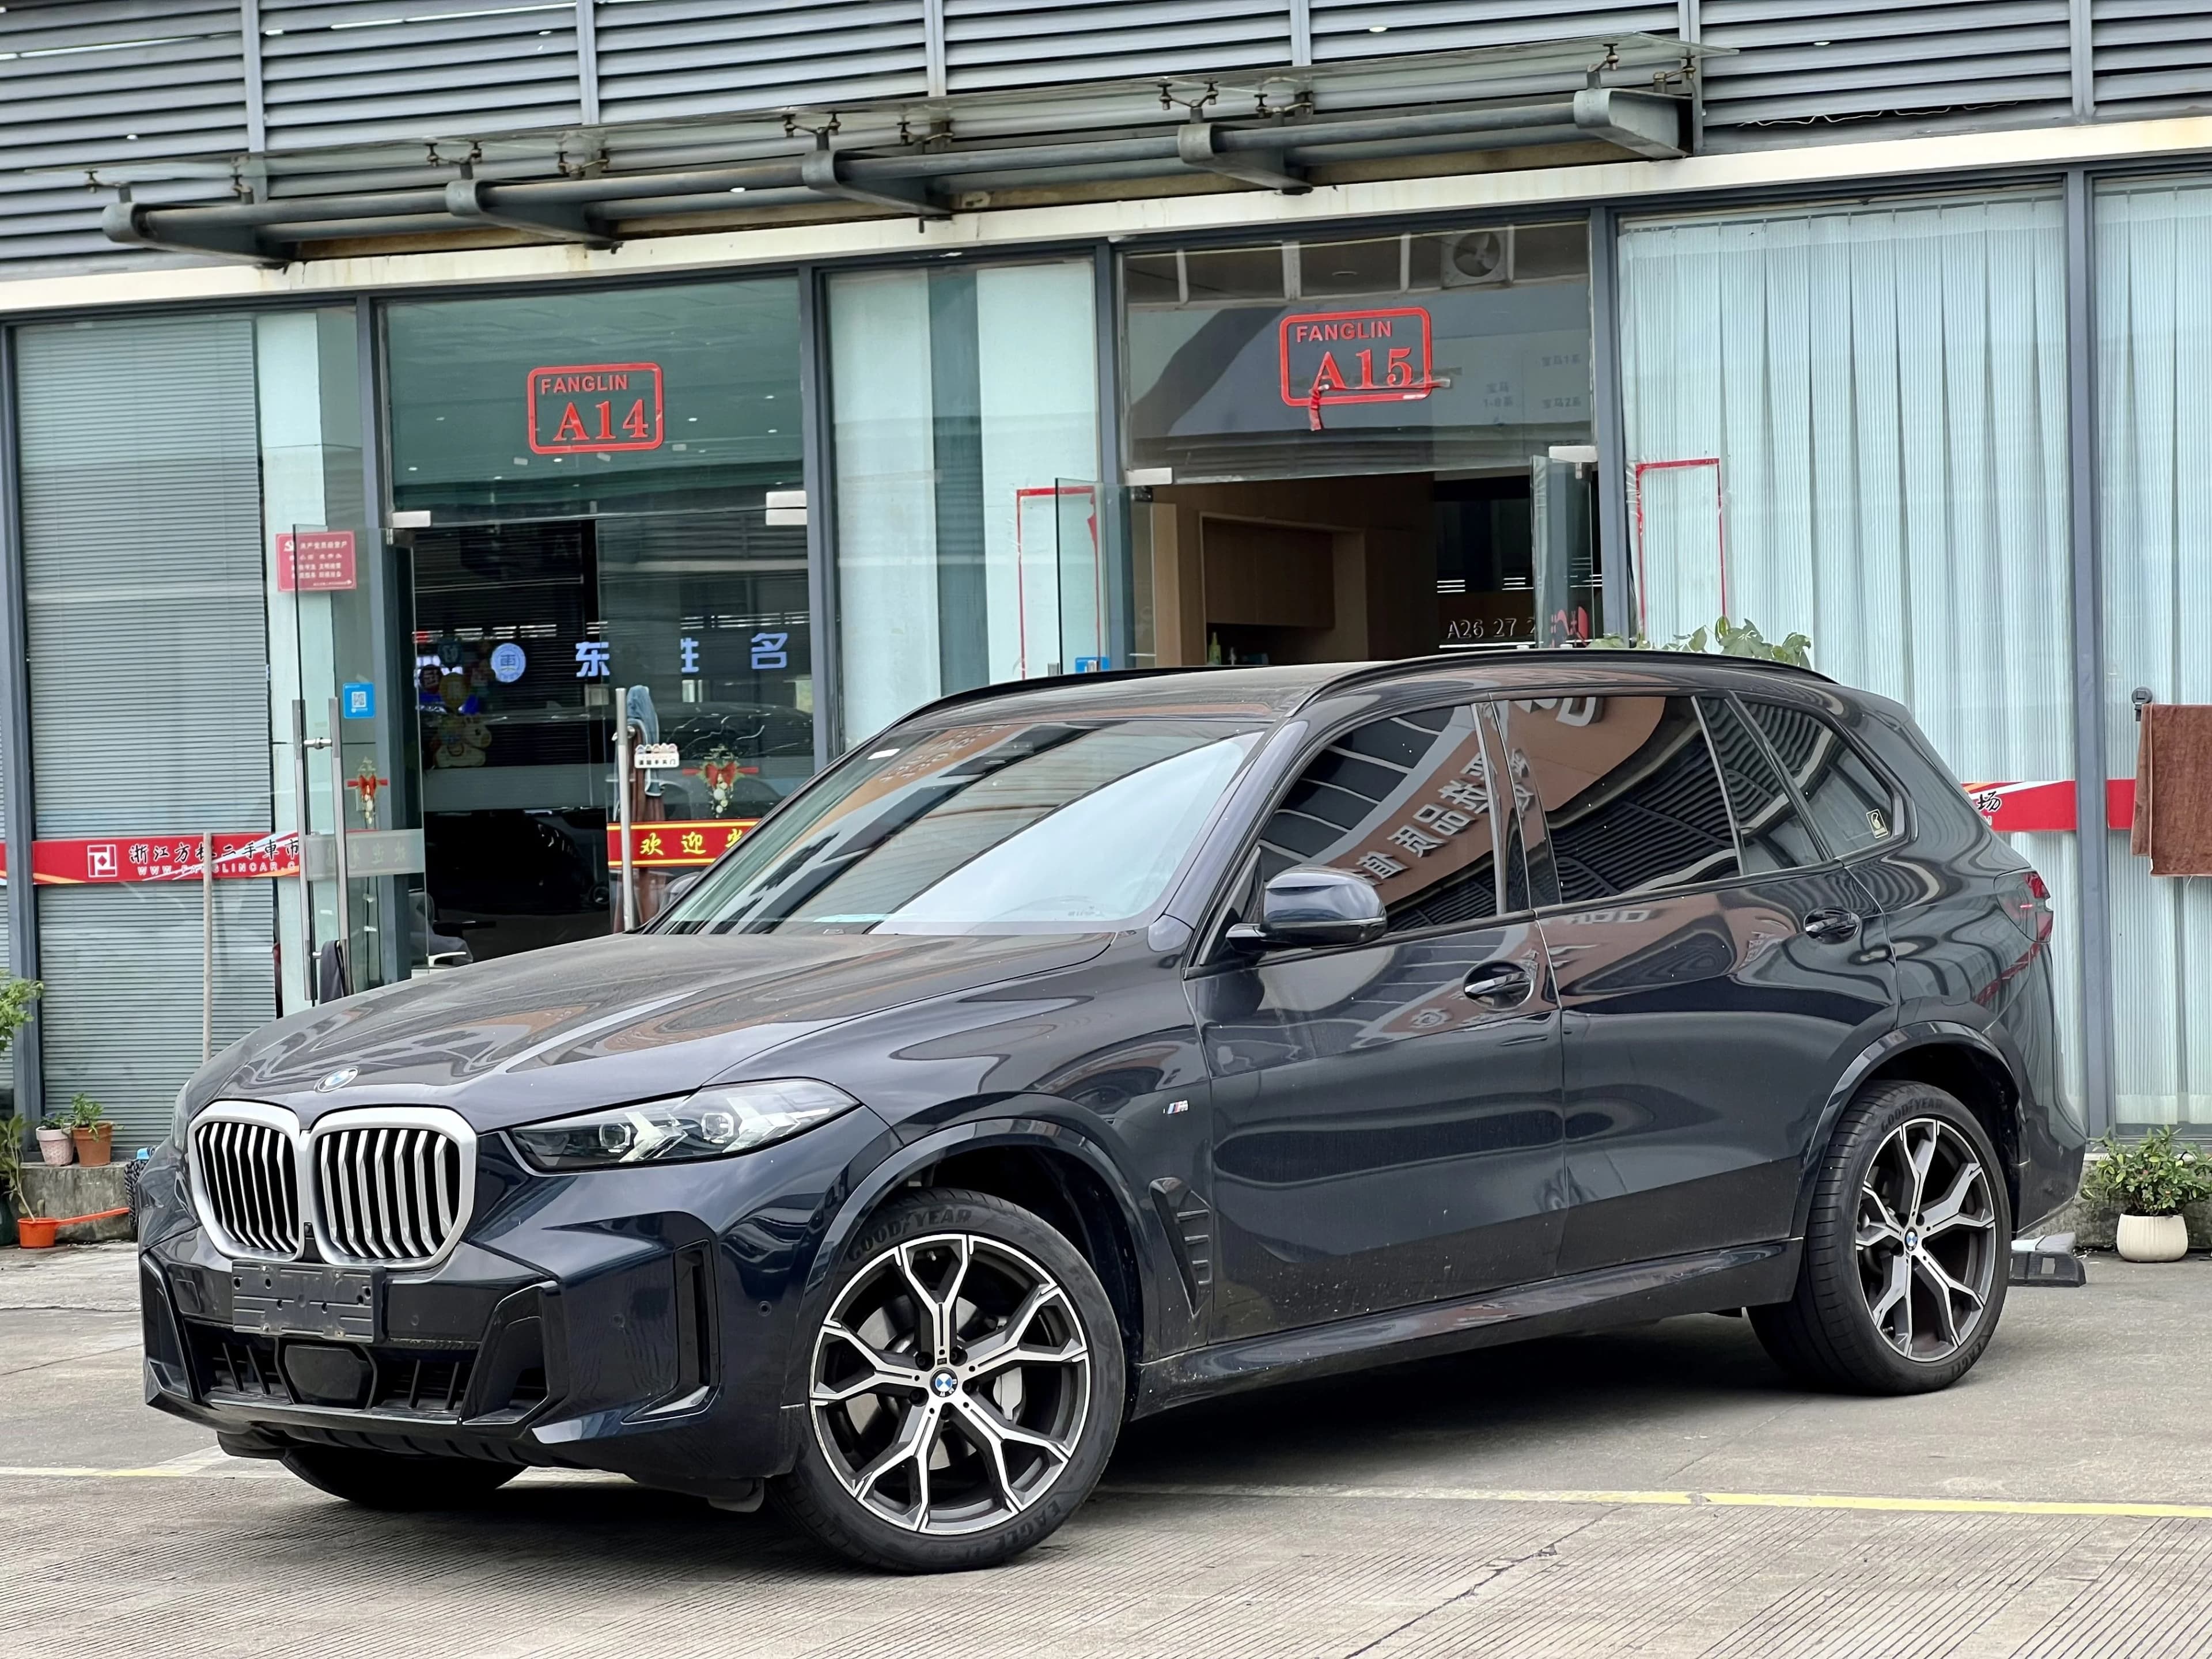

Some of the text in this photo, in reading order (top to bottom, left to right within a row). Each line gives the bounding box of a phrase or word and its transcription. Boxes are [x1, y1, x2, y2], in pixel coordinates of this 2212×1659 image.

[1296, 320, 1392, 343] FANGLIN
[541, 374, 628, 395] FANGLIN
[1310, 347, 1413, 391] A15
[552, 399, 649, 442] A14
[1447, 619, 1484, 639] A26
[1493, 618, 1517, 638] 27
[1881, 1097, 1944, 1133] GOODYEAR
[847, 1209, 972, 1262] GOODYEAR
